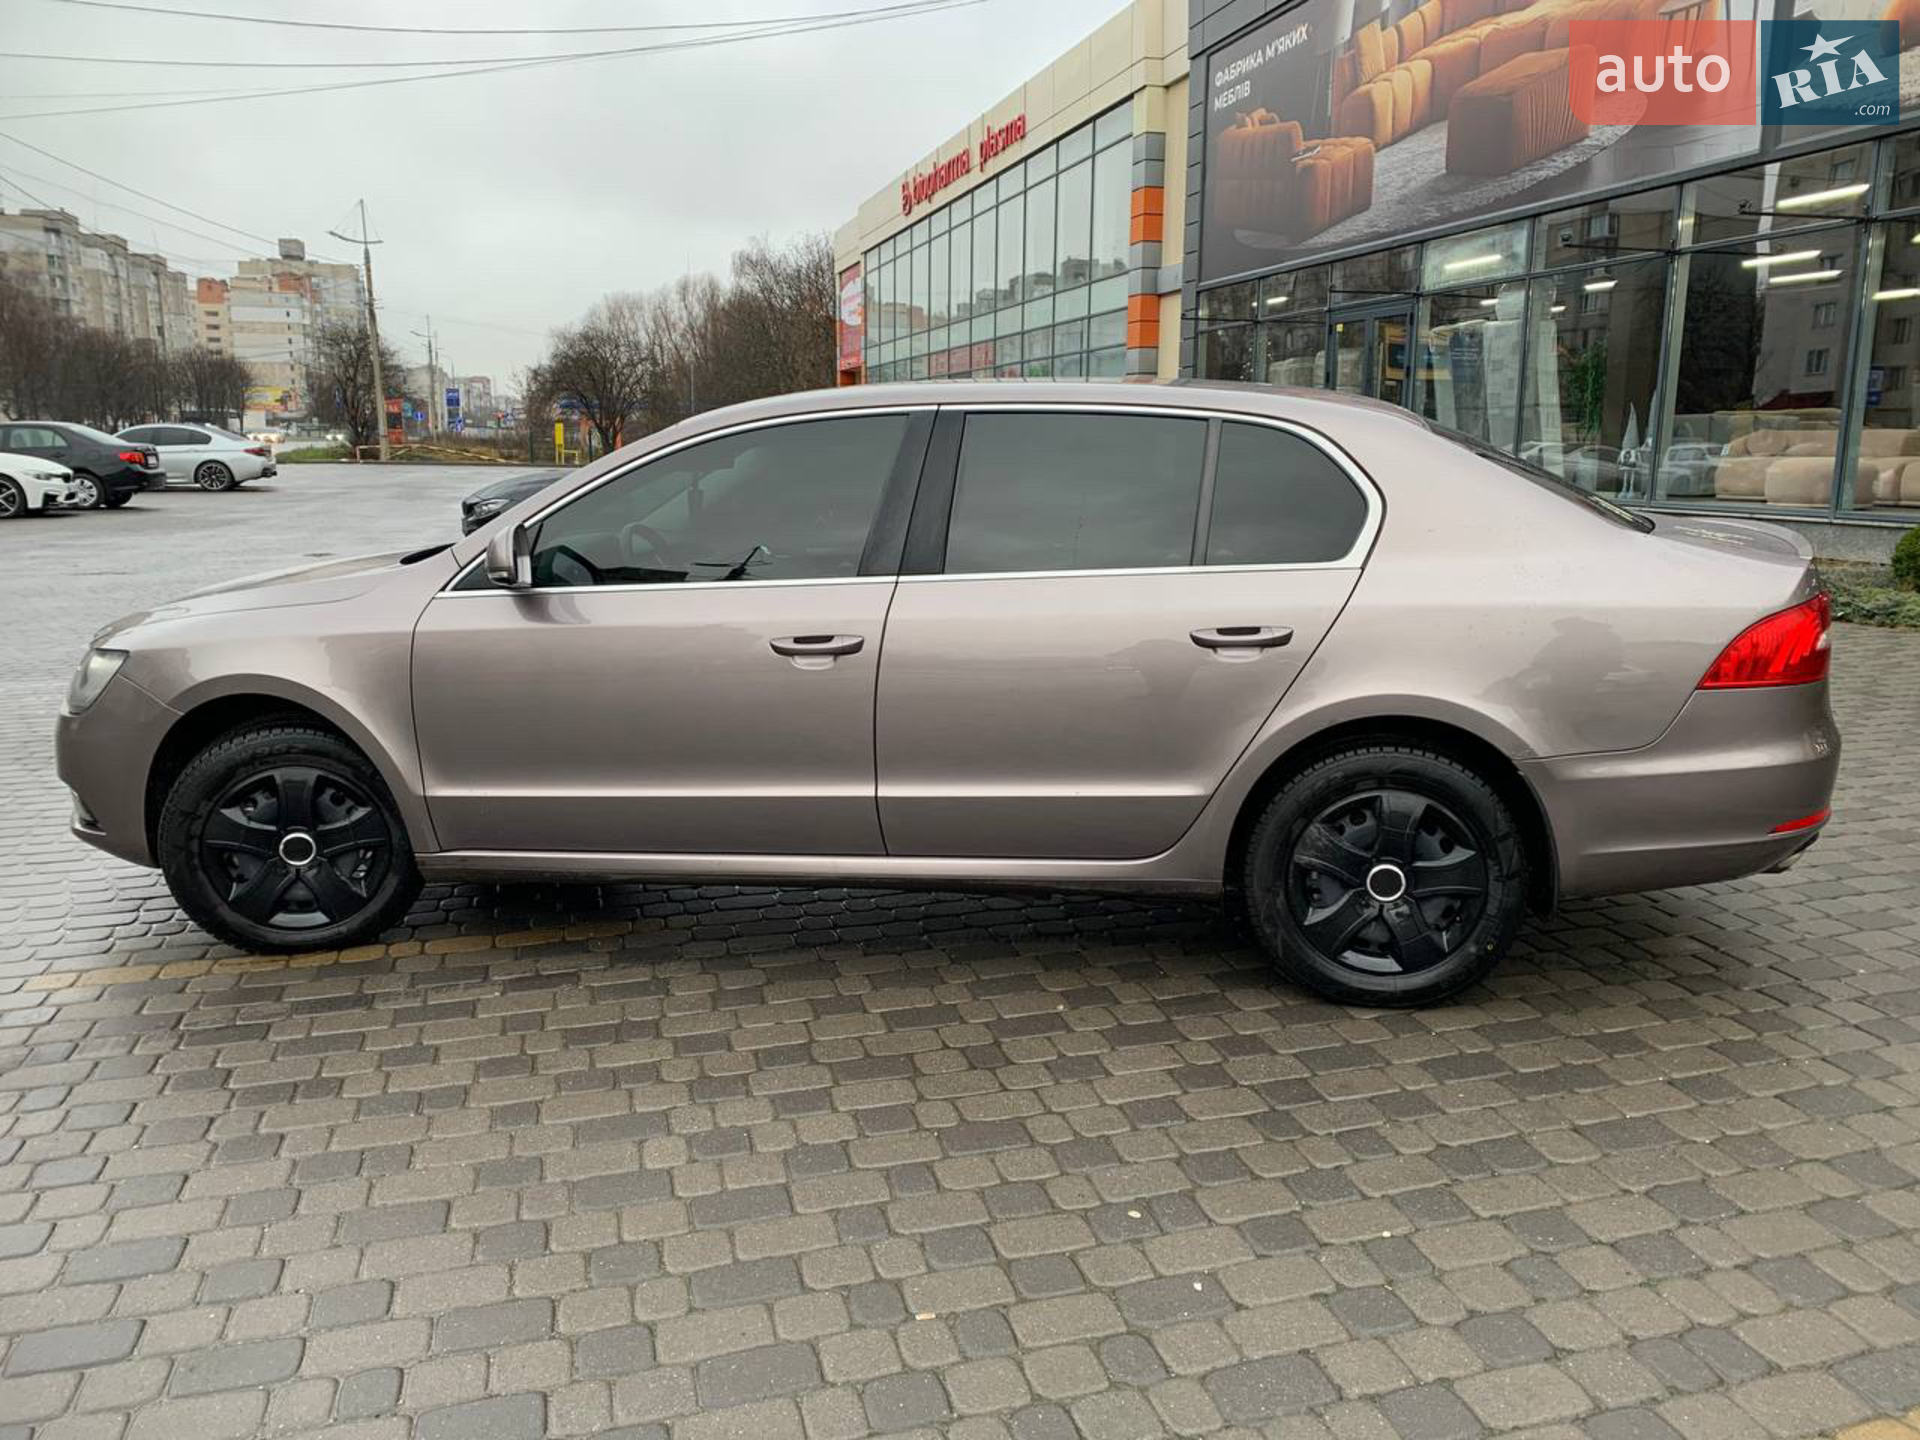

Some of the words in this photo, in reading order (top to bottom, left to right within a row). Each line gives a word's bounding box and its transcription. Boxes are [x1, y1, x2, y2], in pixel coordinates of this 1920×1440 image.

[1214, 48, 1264, 87] ФАБРИКА
[1214, 80, 1251, 112] МЕБЛІВ
[913, 148, 971, 206] biopharma
[979, 113, 1027, 173] plasma
